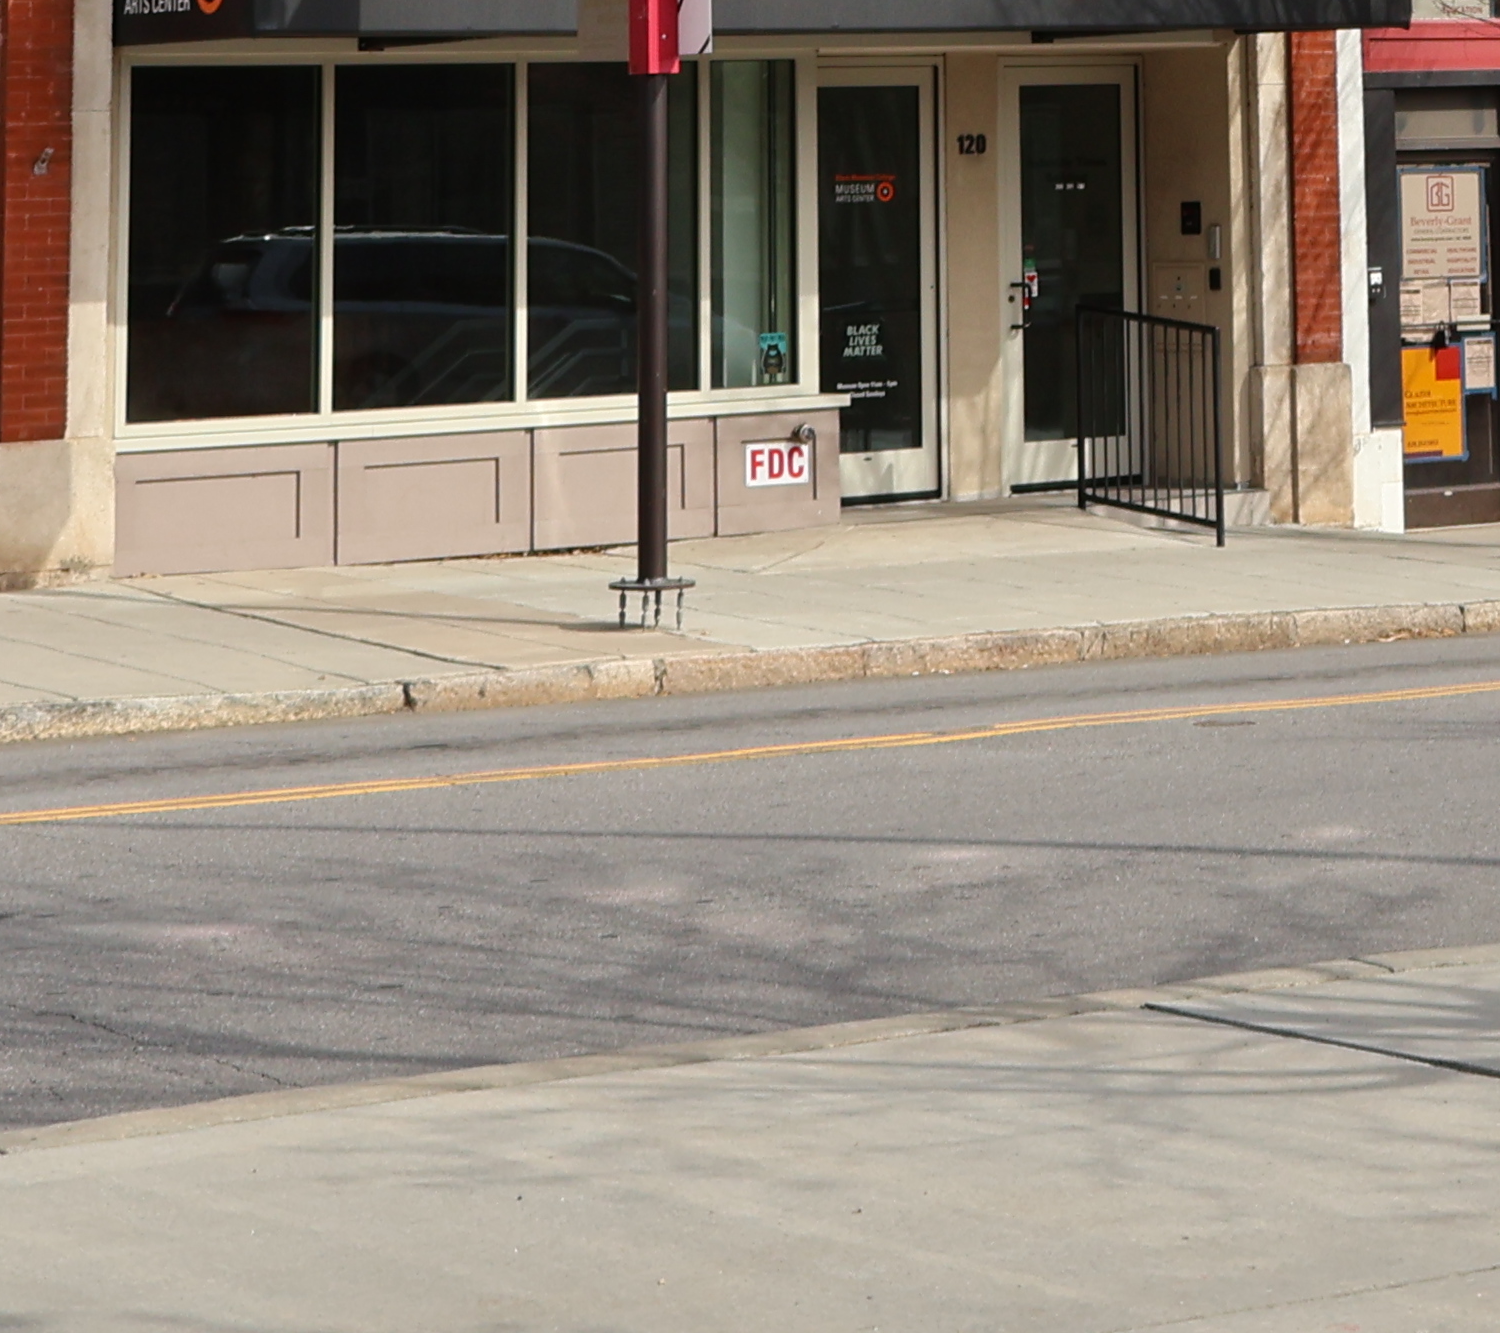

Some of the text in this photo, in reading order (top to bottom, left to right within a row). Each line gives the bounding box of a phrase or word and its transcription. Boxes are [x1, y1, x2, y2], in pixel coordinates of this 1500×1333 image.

[956, 134, 987, 155] 120
[835, 184, 875, 194] MUSEUM
[835, 194, 875, 203] ARTS CENTER
[846, 324, 880, 337] BLACK
[849, 335, 877, 346] LIVES
[842, 345, 883, 357] MATTER
[750, 446, 805, 481] FDC
